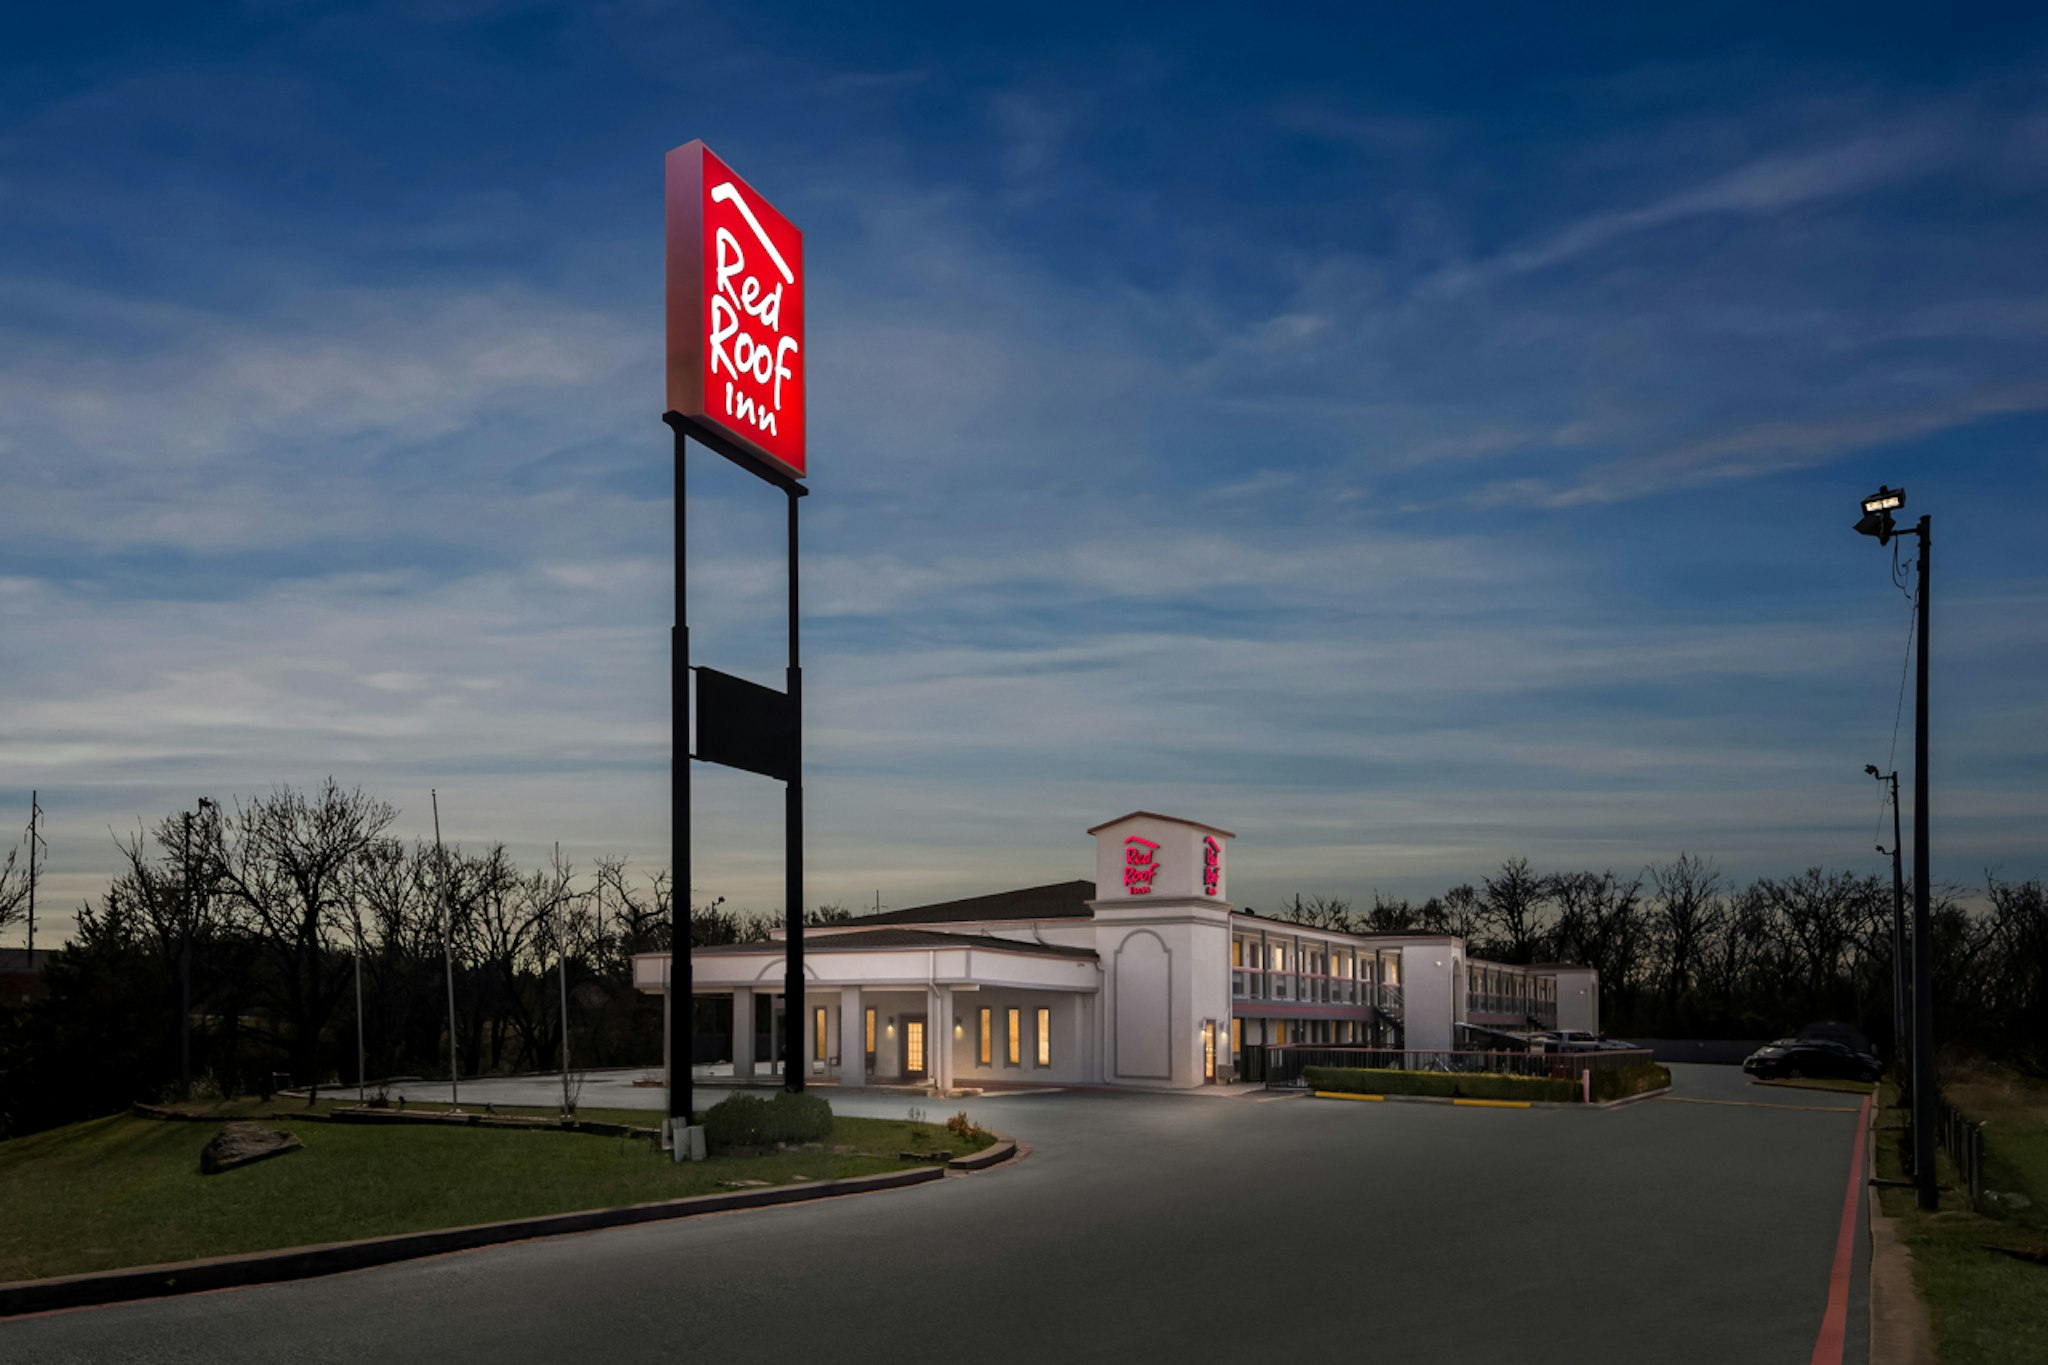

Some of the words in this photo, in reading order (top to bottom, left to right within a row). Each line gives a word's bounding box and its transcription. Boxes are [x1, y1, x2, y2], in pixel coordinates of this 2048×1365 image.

[716, 226, 783, 332] Red
[709, 294, 798, 411] Roof
[1123, 863, 1159, 887] Roof
